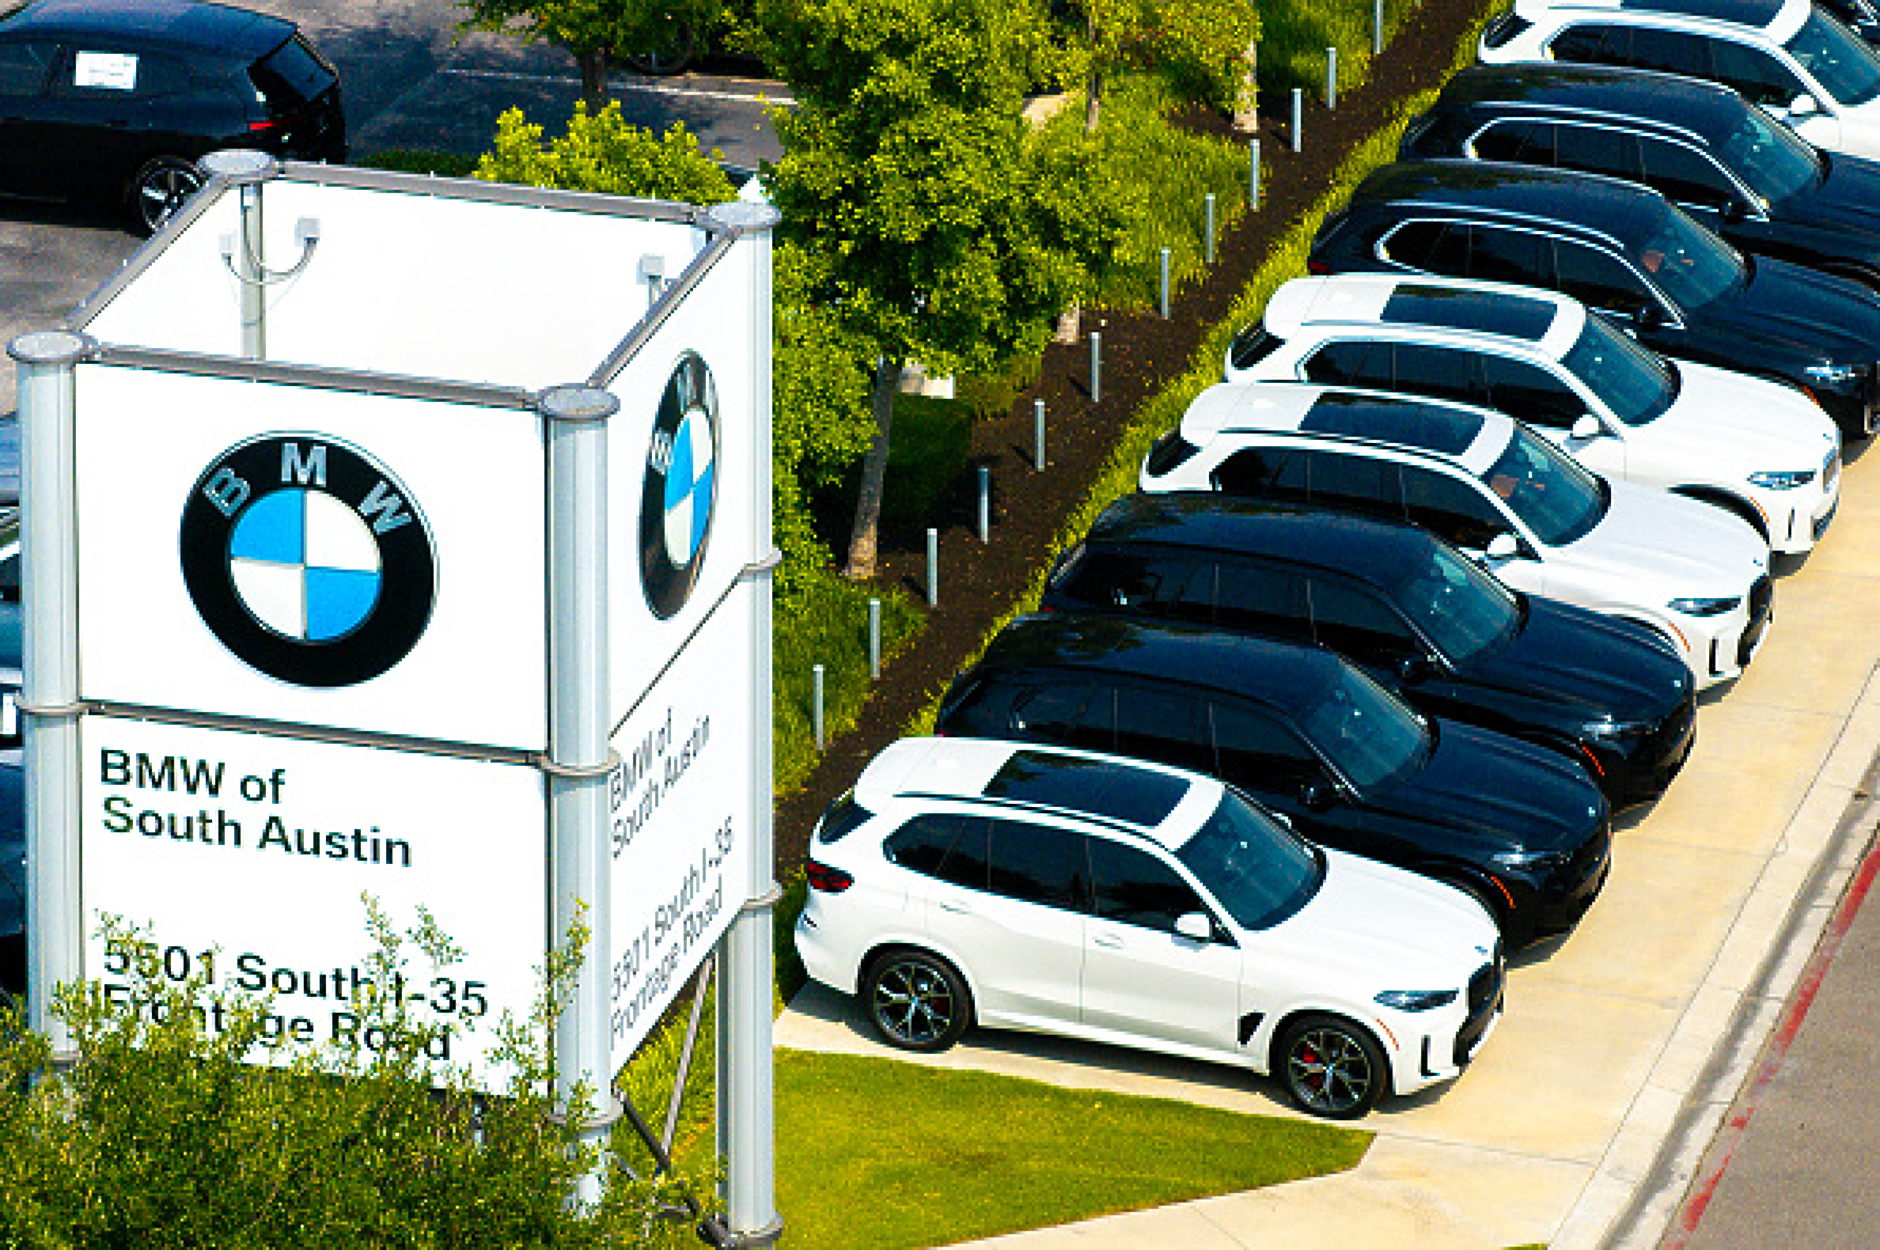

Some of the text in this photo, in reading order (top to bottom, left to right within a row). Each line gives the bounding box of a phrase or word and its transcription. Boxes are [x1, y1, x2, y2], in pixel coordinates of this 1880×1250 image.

[202, 442, 413, 536] BMW
[101, 747, 286, 804] BMW of
[611, 729, 653, 814] BMW
[611, 714, 710, 861] South Austin
[102, 794, 413, 868] South Austin
[654, 863, 700, 946] South
[683, 872, 723, 955] Road
[104, 939, 488, 1016] 5501 South I-35
[331, 1009, 450, 1060] Rod
